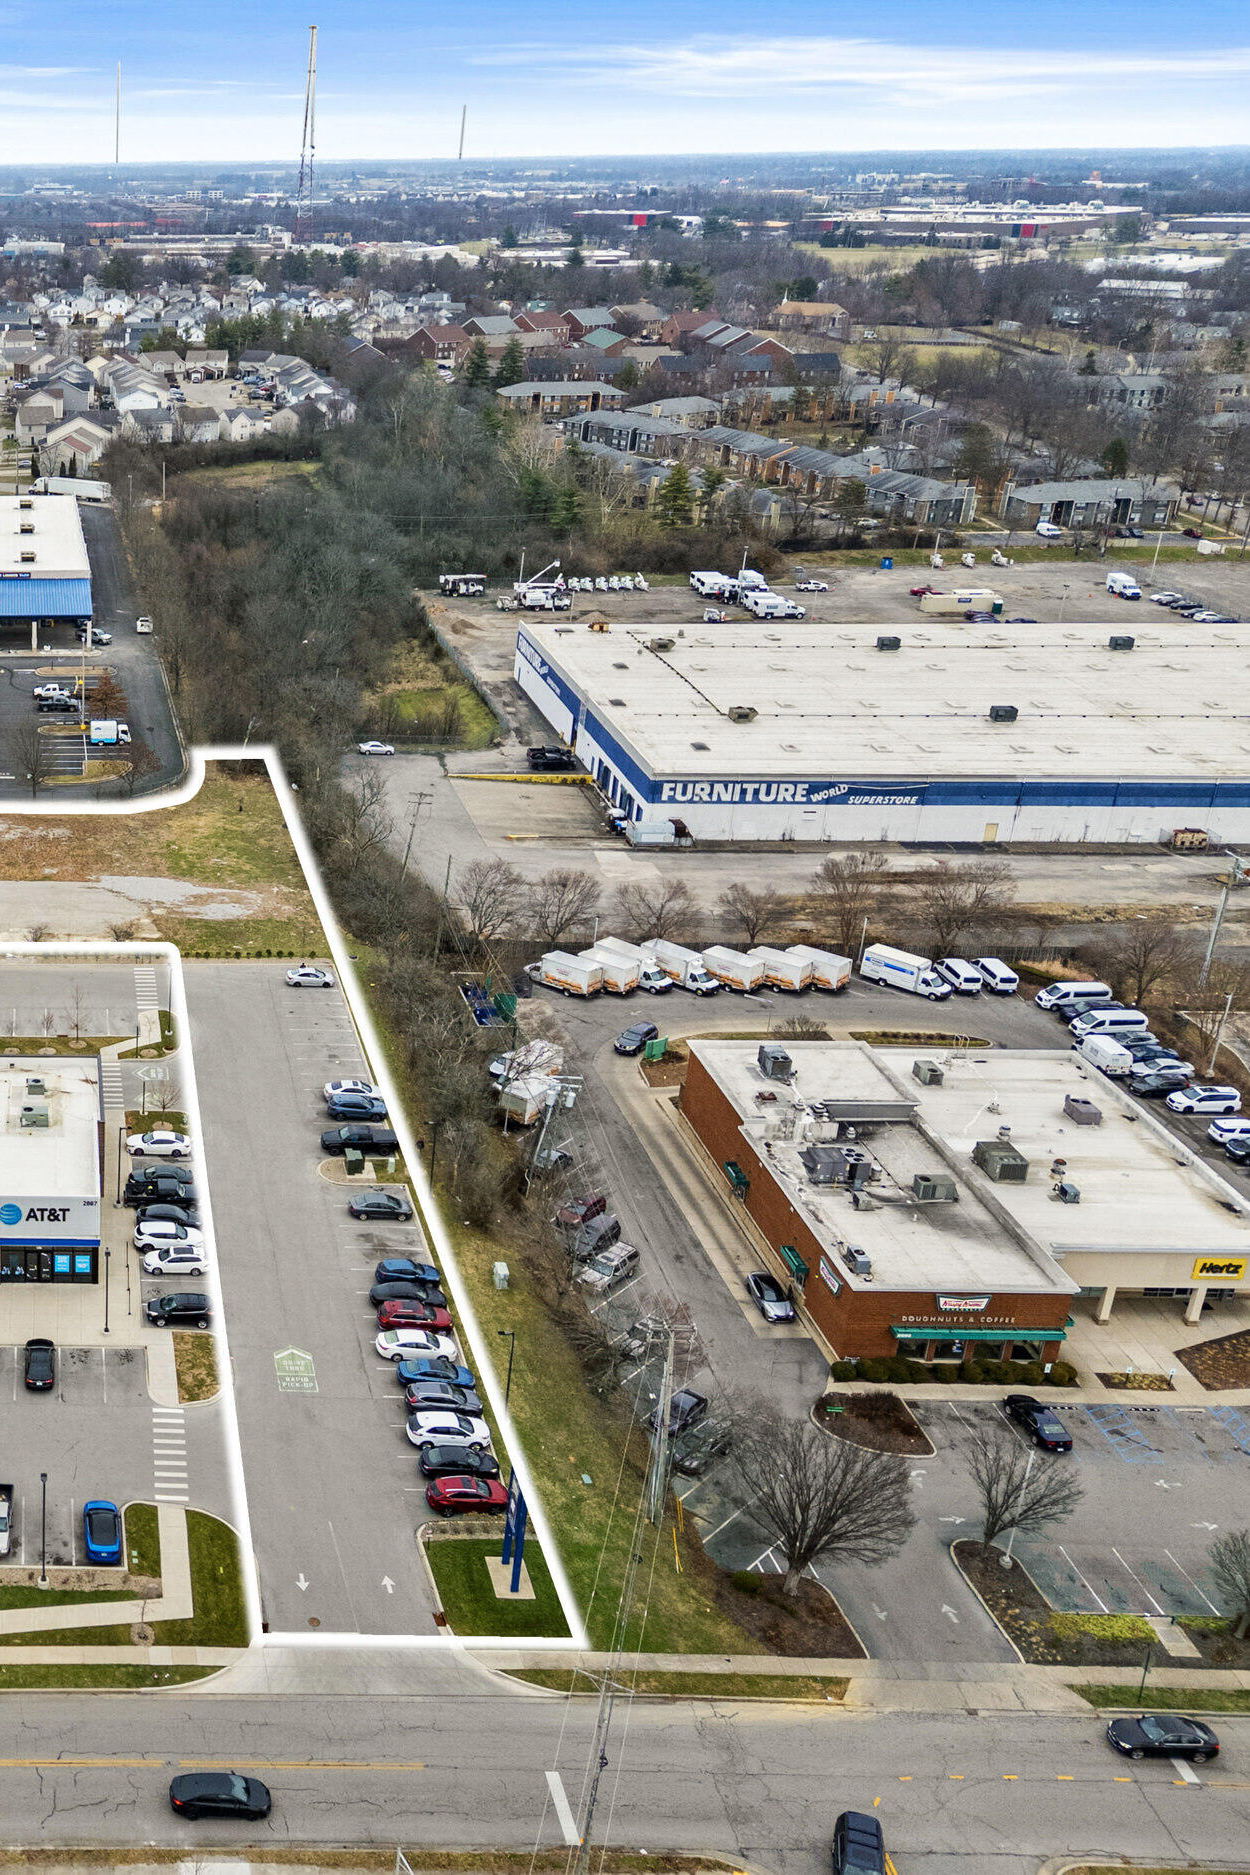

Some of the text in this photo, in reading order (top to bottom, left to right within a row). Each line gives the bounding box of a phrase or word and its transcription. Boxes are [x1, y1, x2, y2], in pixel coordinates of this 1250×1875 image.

[661, 782, 918, 805] FURNITURE WORLD SUPERSTORE
[25, 1208, 70, 1222] AT&T
[1199, 1262, 1243, 1274] Hertz
[901, 1315, 964, 1323] DOUGHNUTS
